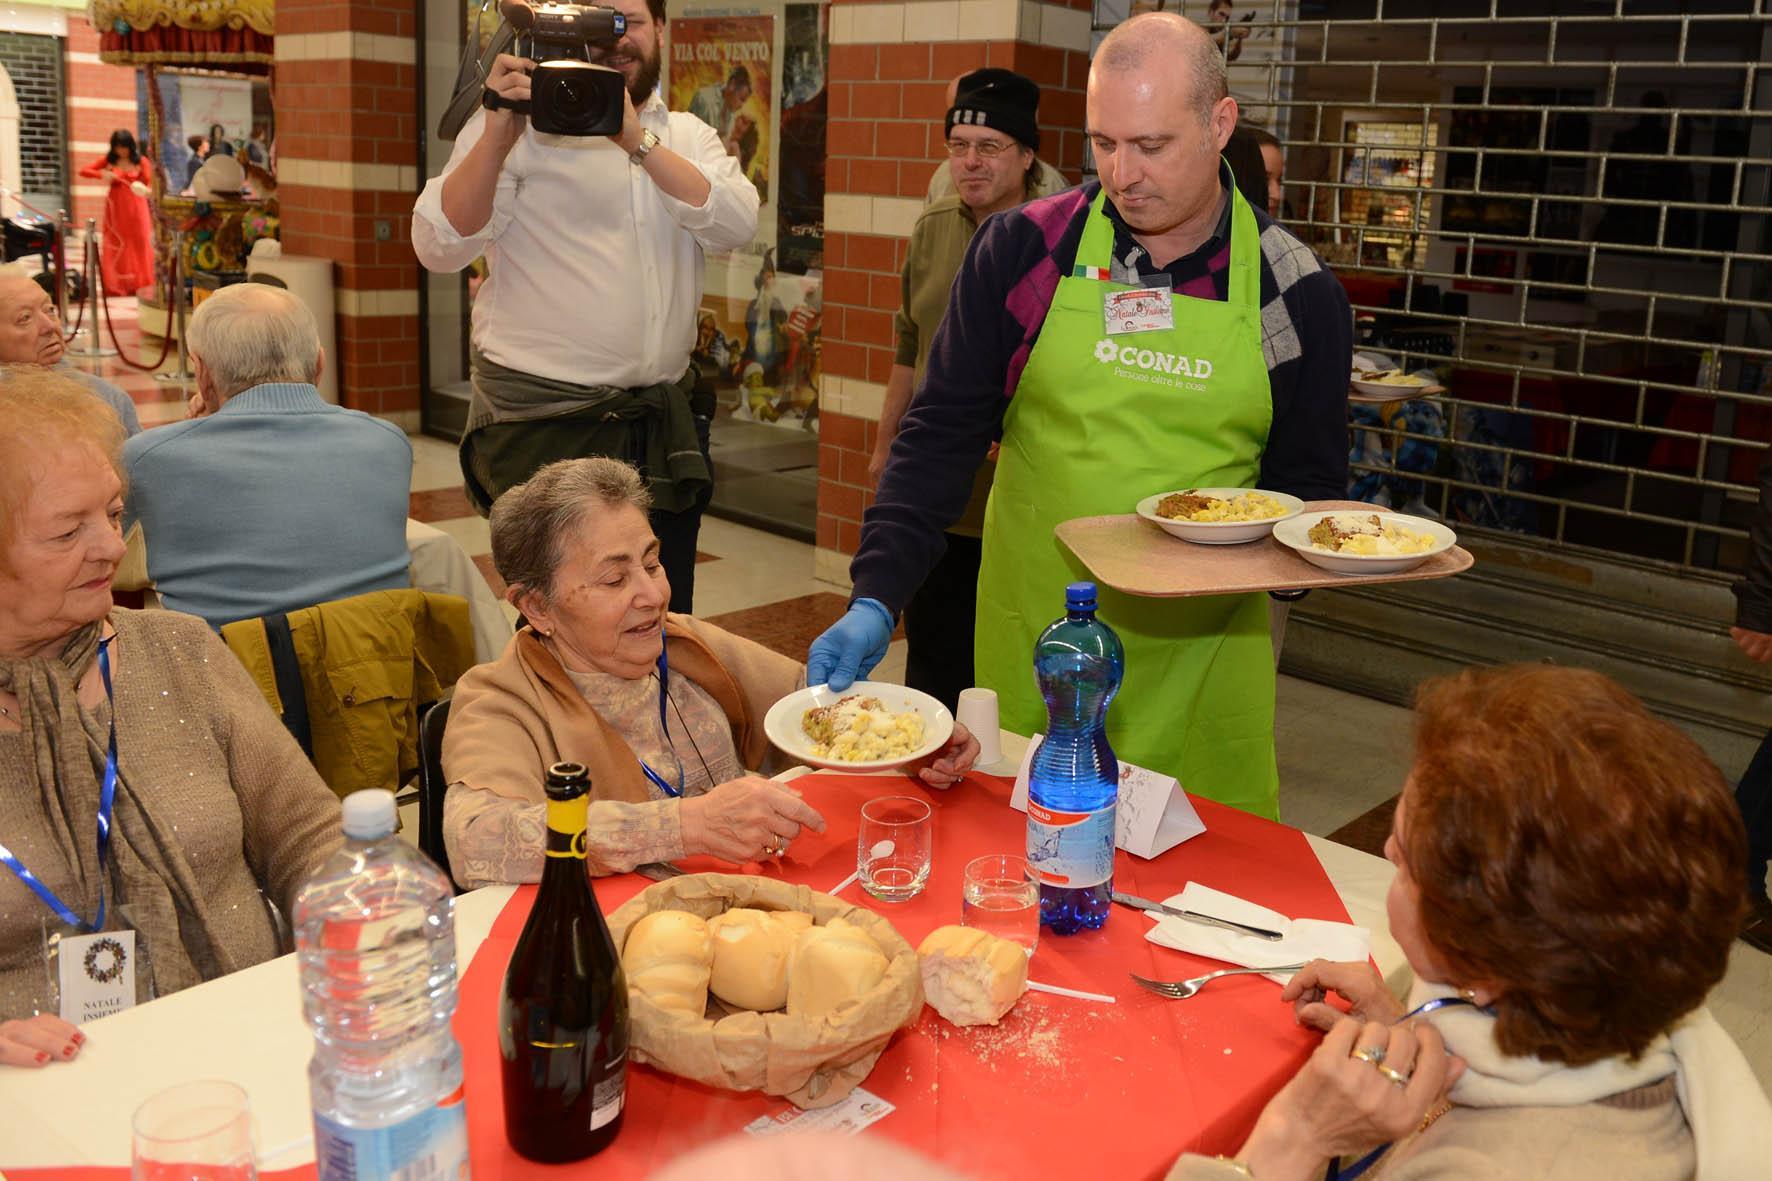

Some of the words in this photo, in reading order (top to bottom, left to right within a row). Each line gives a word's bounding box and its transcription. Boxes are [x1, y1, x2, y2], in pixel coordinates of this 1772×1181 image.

[673, 43, 695, 61] VIA
[696, 43, 722, 61] COL
[724, 41, 770, 61] VENTO
[1119, 346, 1214, 379] CONAD
[1114, 367, 1149, 383] Persone
[1151, 374, 1173, 387] oltre
[1175, 378, 1184, 388] le
[1186, 382, 1207, 392] cose
[83, 997, 121, 1010] NATALE
